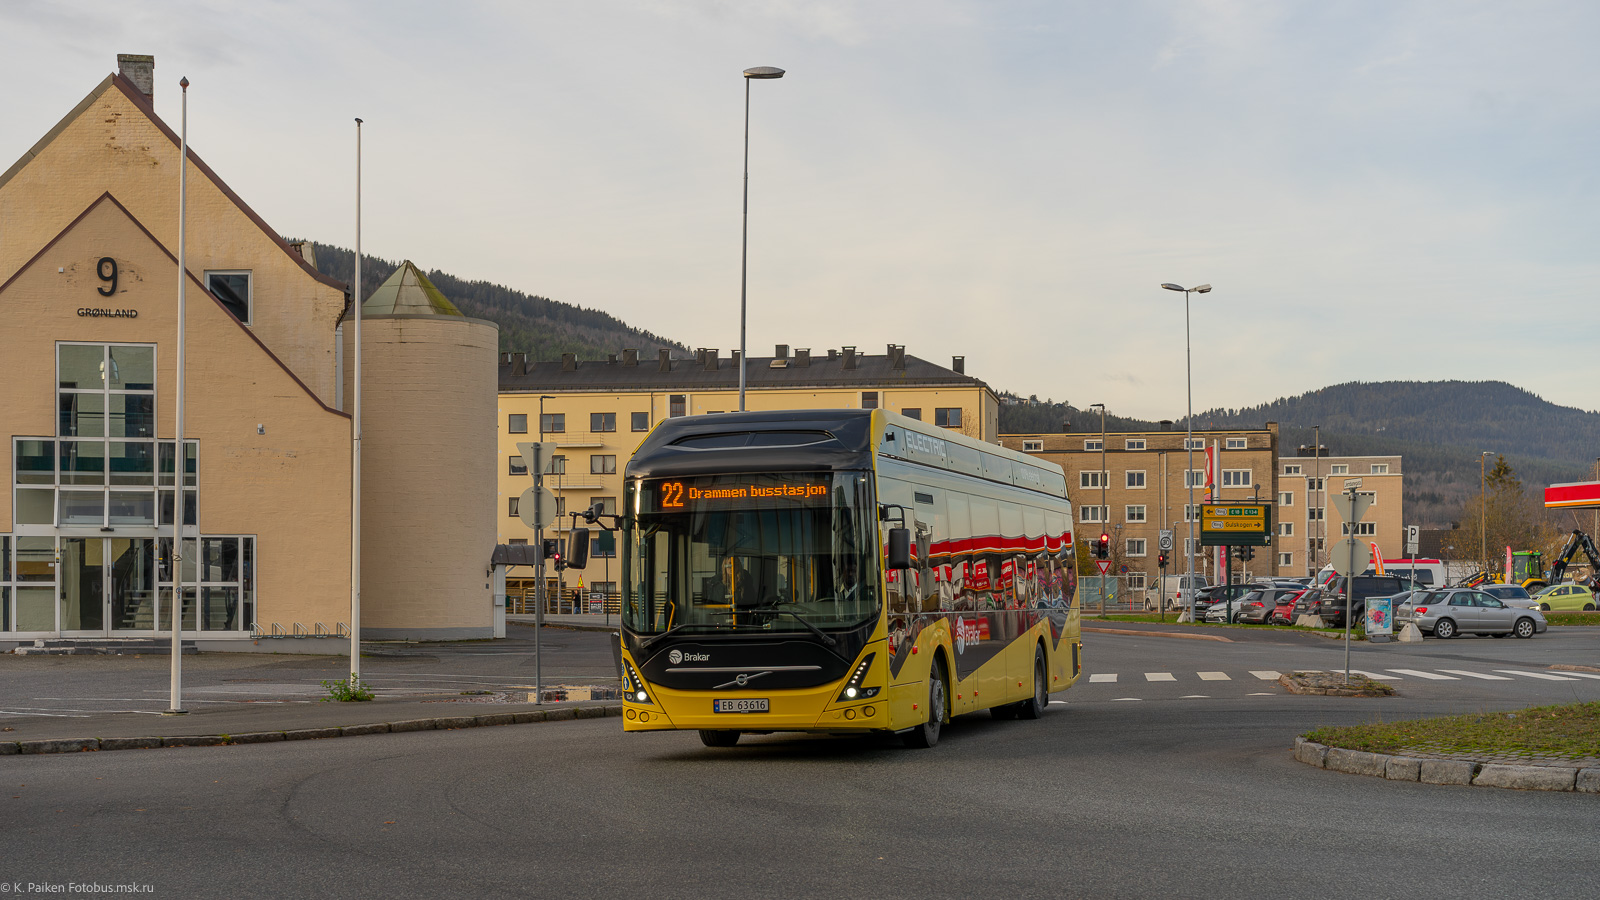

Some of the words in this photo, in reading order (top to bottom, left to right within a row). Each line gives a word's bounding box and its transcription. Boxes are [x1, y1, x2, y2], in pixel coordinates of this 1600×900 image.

[97, 257, 118, 297] 9
[77, 308, 138, 318] GRØNLAND
[905, 431, 947, 458] ELECTRIC
[662, 482, 684, 507] 22
[689, 487, 747, 499] Drammen
[750, 484, 827, 498] busstasjon
[1411, 528, 1417, 541] P
[684, 652, 710, 662] Brakar
[722, 701, 734, 710] EB
[737, 700, 766, 710] 63616
